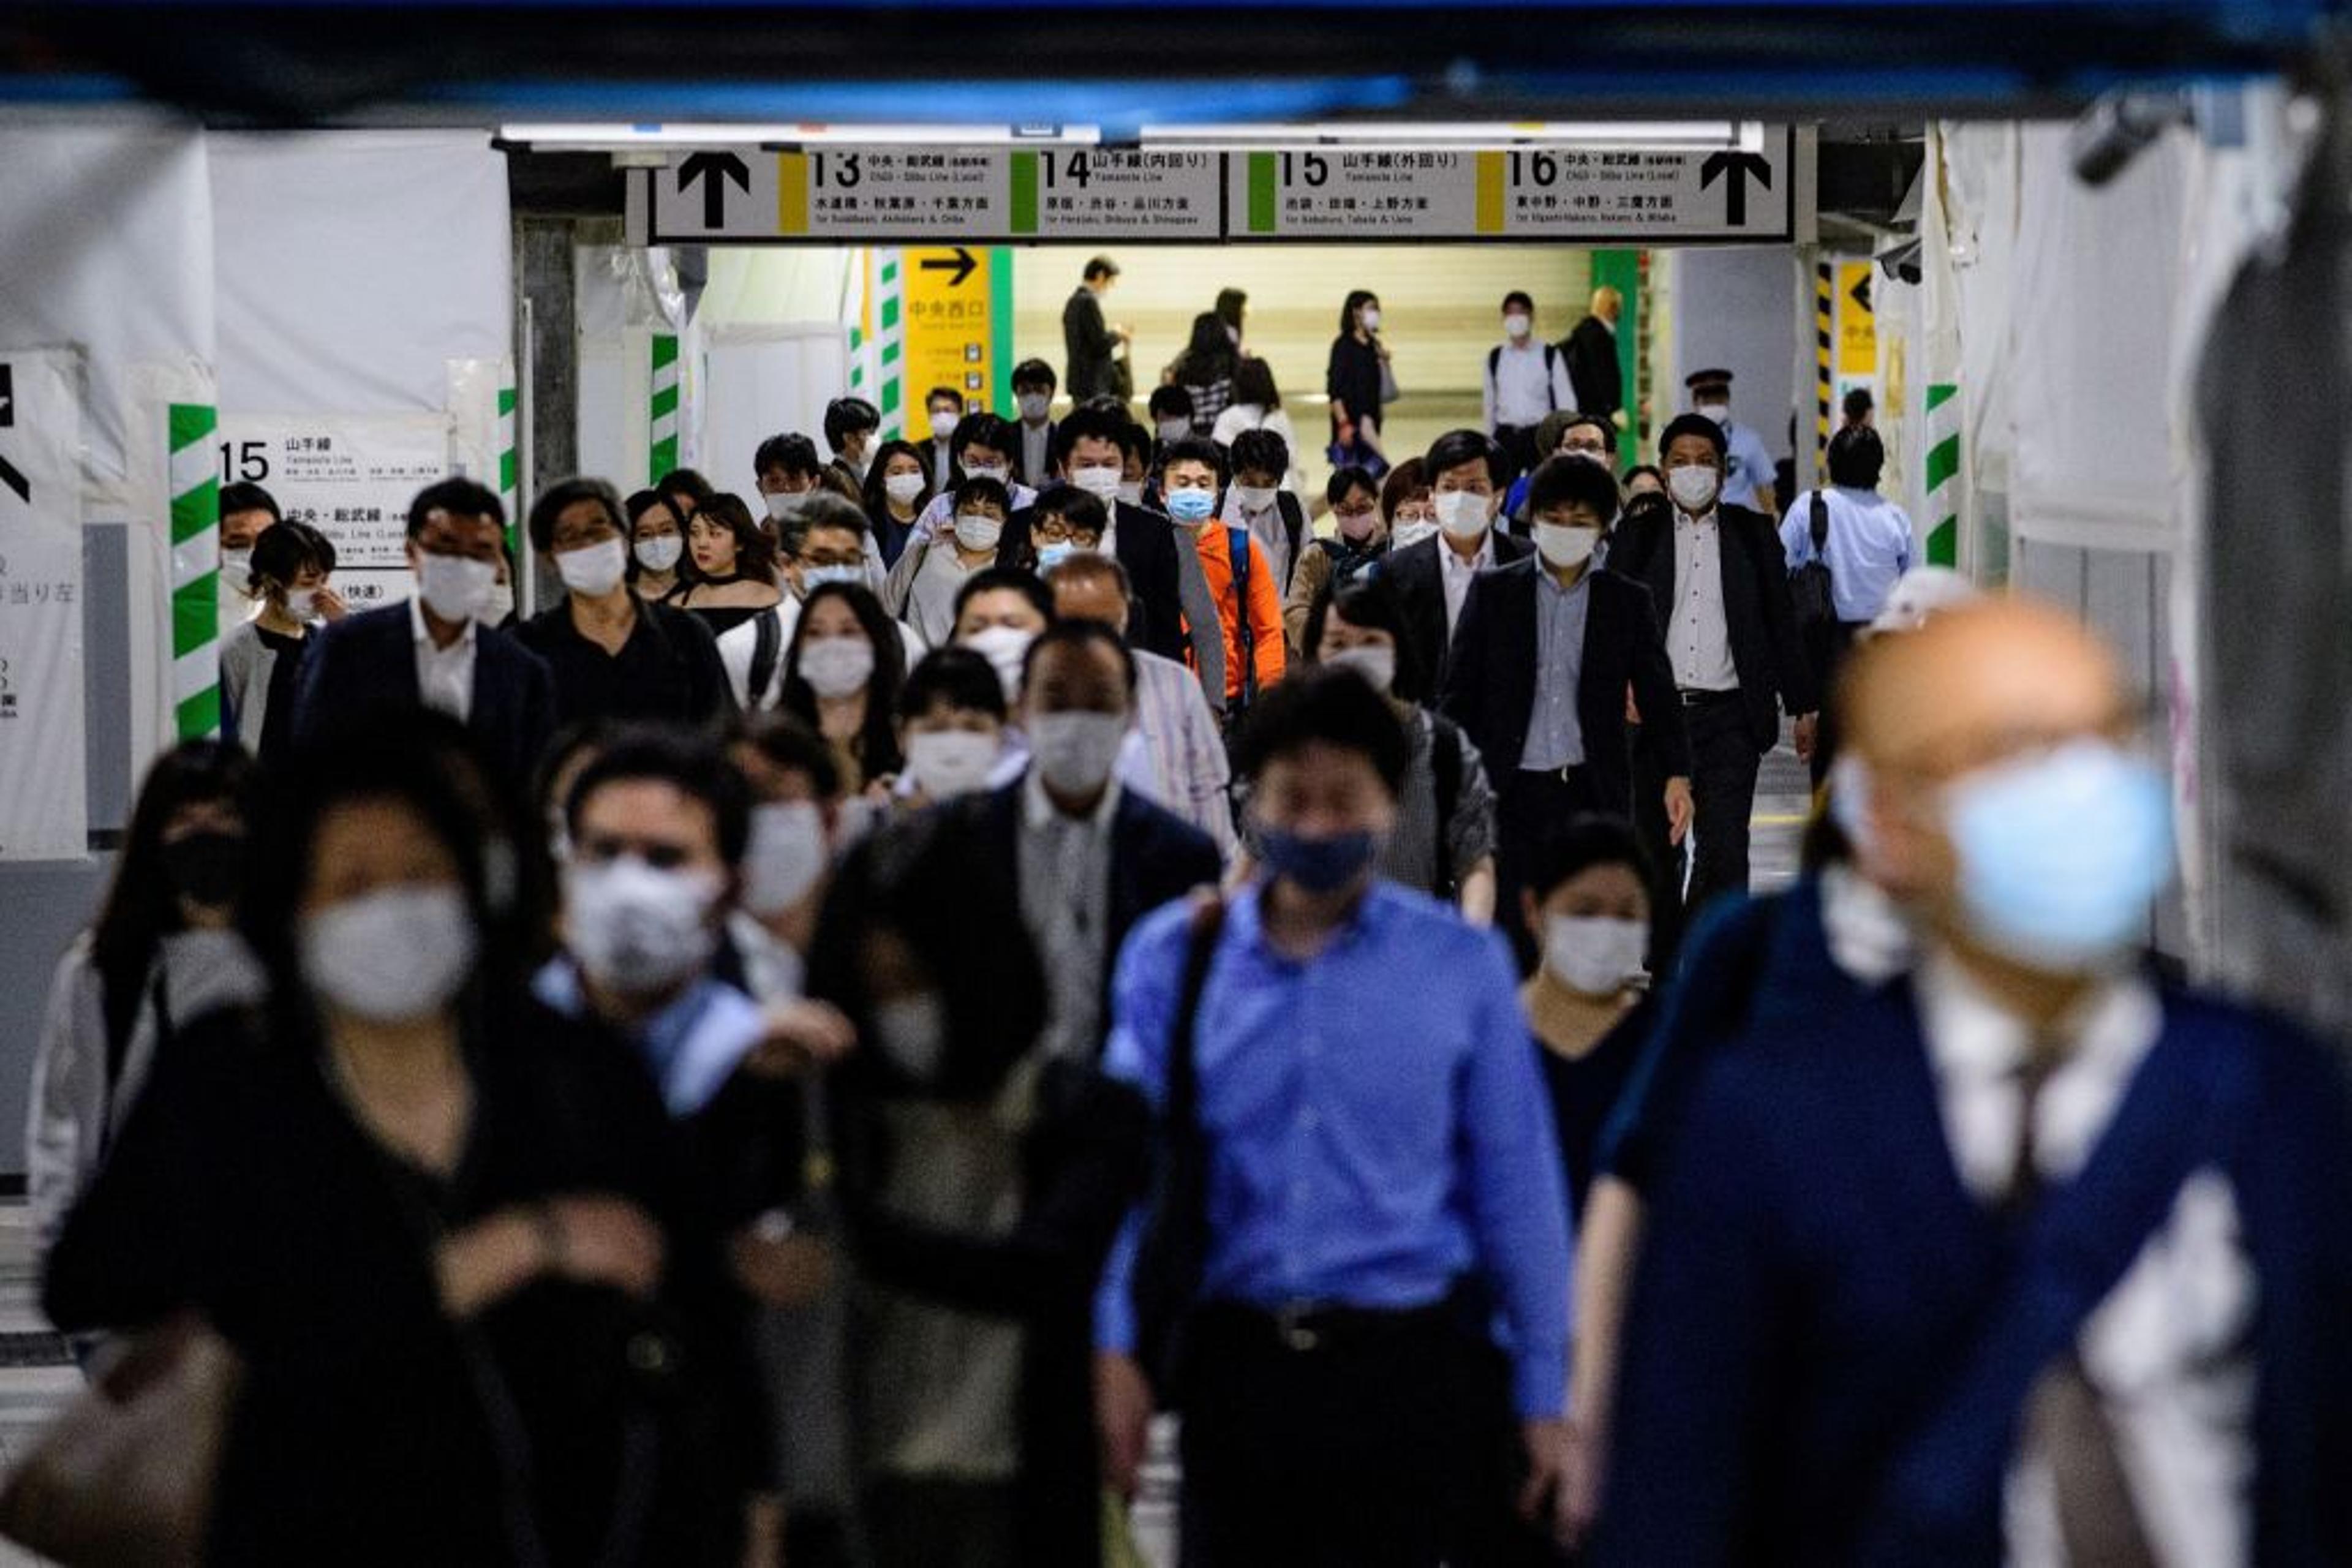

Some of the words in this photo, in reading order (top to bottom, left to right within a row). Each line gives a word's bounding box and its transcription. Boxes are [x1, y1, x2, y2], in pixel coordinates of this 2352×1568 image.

[812, 152, 860, 187] 13
[1041, 151, 1090, 188] 14
[1280, 151, 1328, 186] 15
[1507, 151, 1557, 186] 16
[220, 441, 269, 482] 15
[286, 437, 331, 451] 山手線
[0, 582, 74, 605] 当り左
[342, 584, 384, 599] (快速)
